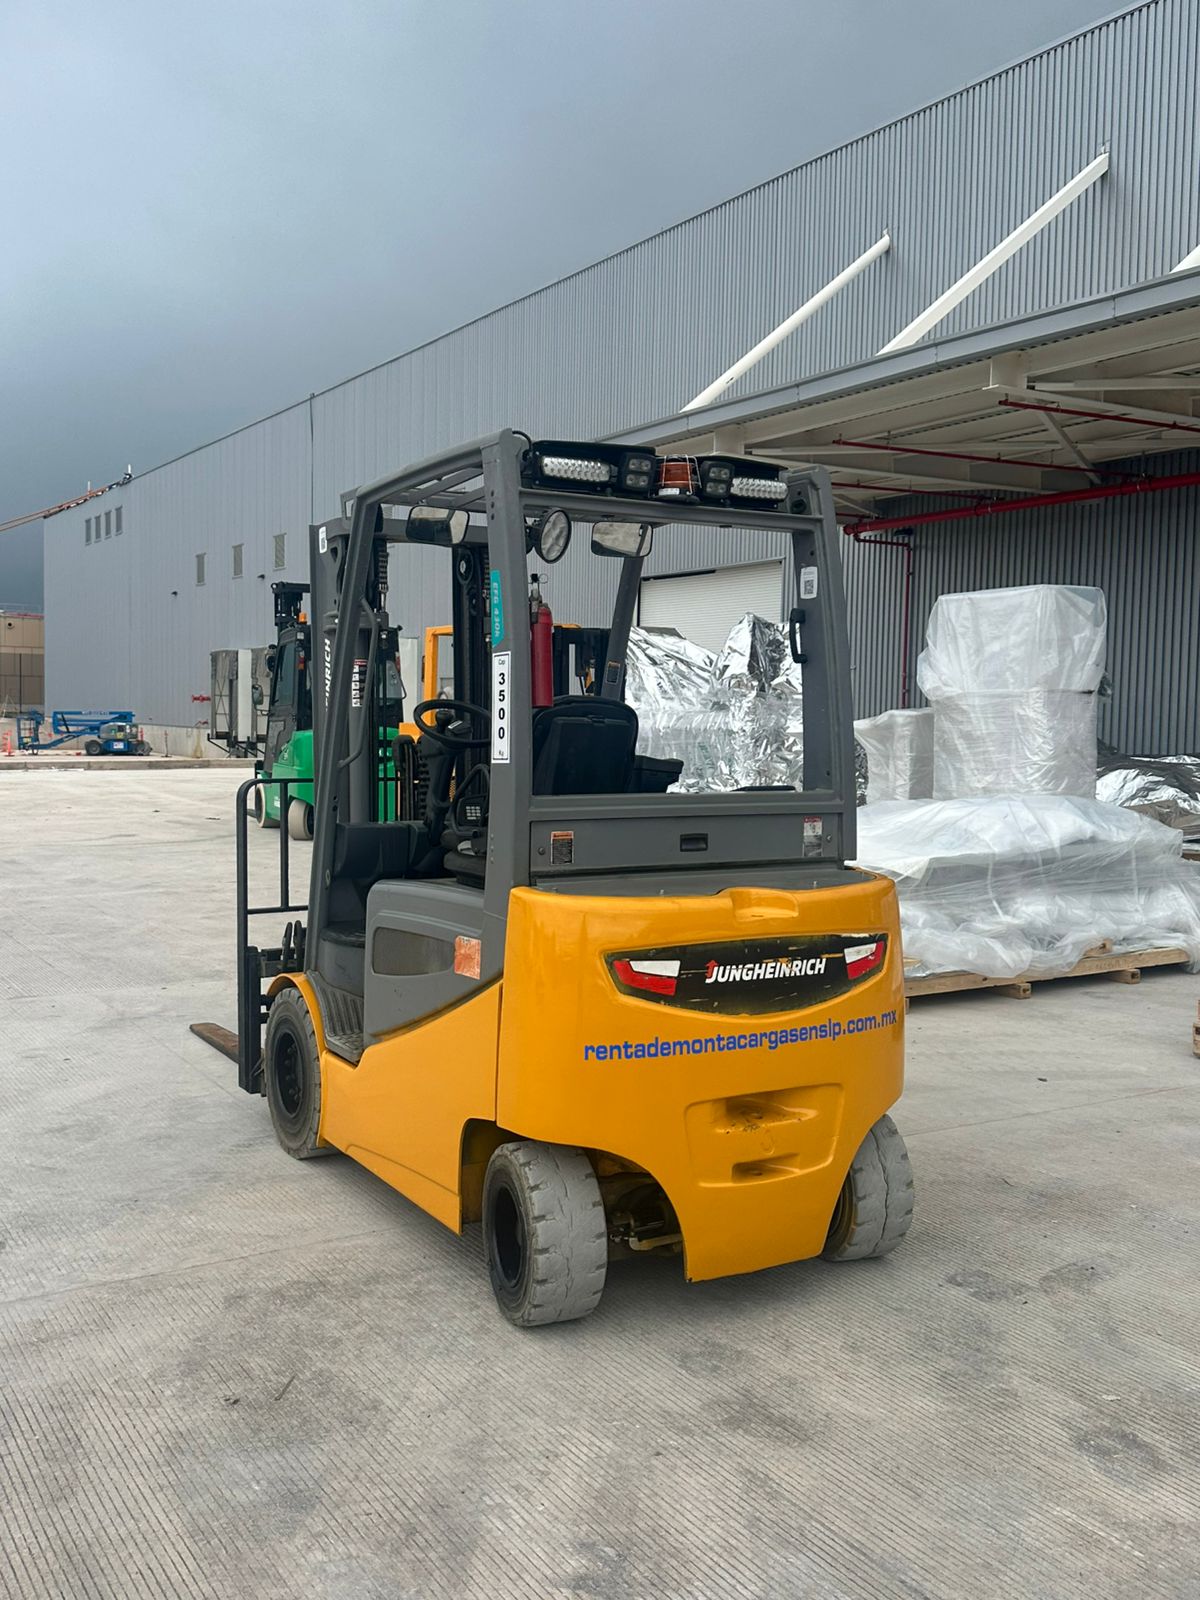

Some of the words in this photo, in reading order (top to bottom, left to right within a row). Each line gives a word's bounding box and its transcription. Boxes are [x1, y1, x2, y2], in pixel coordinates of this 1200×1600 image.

[498, 672, 506, 740] 3500
[705, 958, 827, 984] JUNGHEINRICH
[584, 1009, 897, 1060] rentademontacargasenslp.com.mx
